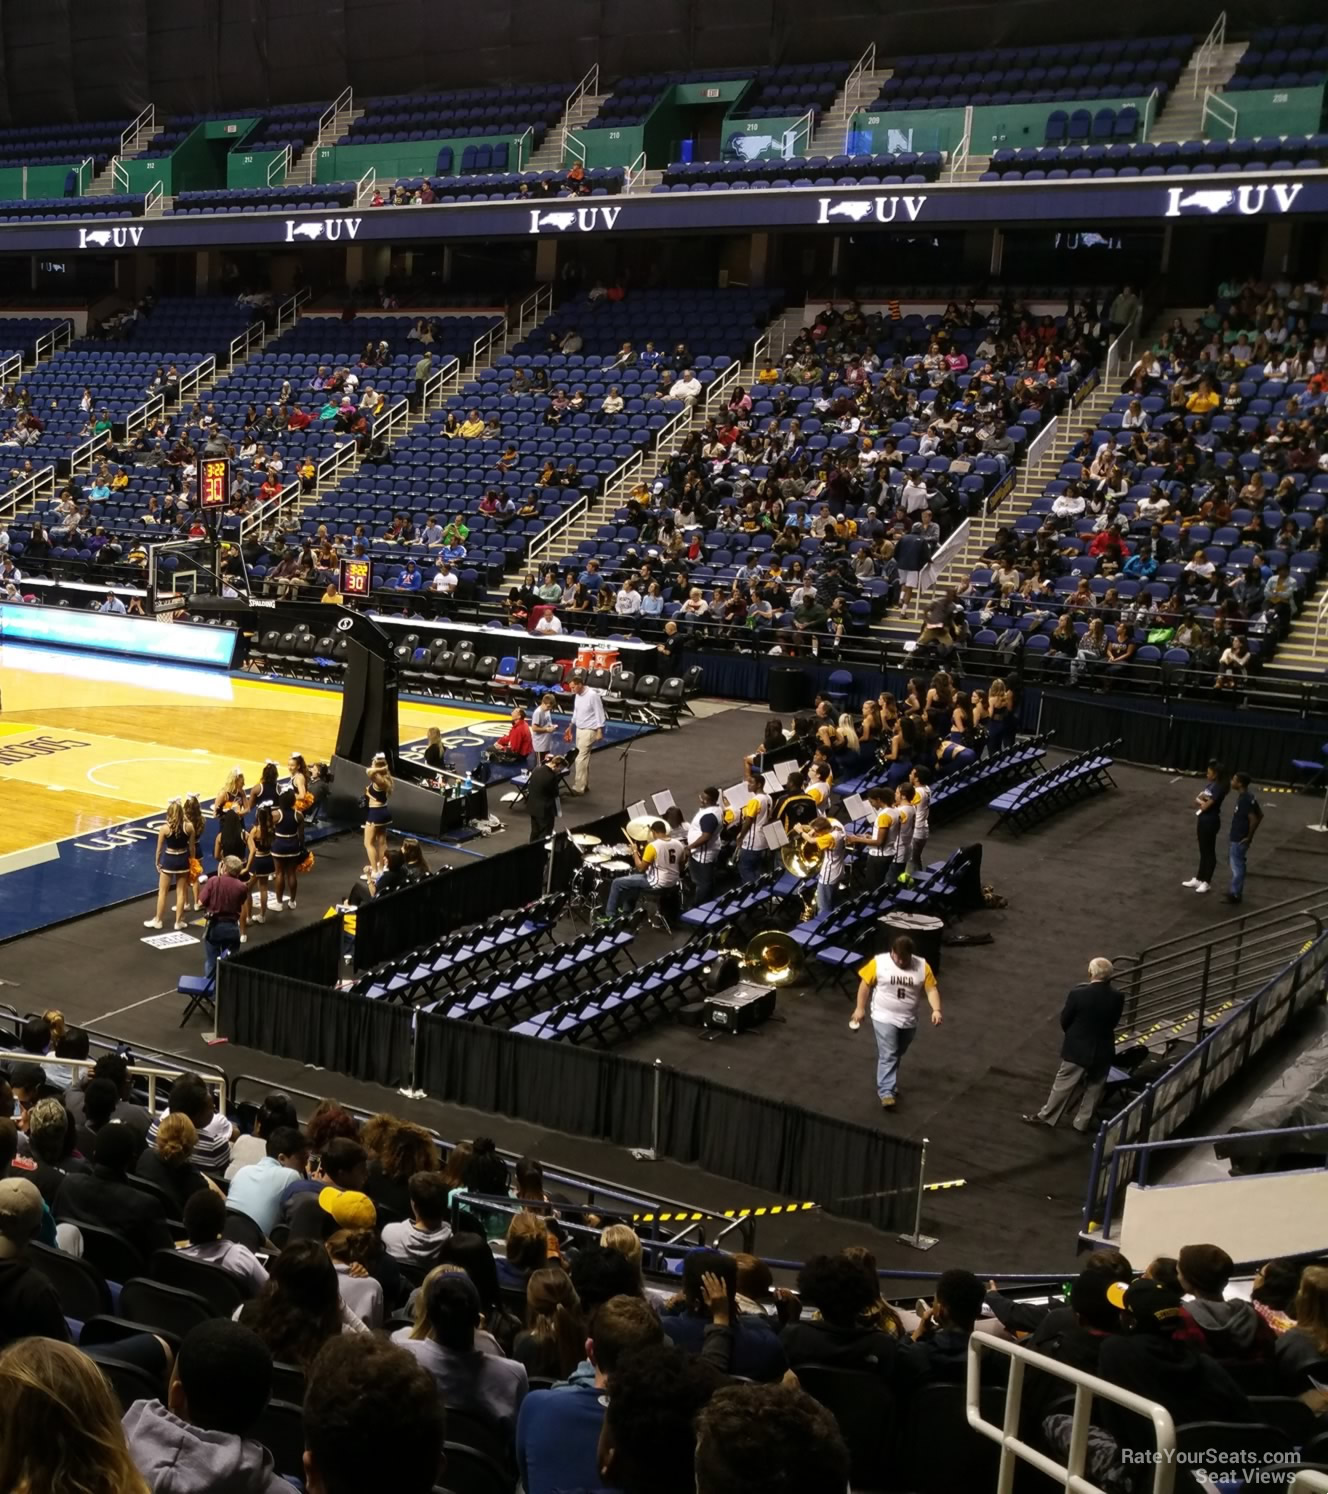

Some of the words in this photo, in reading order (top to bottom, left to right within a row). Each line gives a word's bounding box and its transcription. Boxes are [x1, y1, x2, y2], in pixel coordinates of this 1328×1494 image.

[868, 117, 880, 125] 209
[1238, 184, 1303, 215] UV
[874, 196, 927, 223] UV
[577, 207, 621, 232] UV
[113, 227, 144, 247] UV
[325, 218, 362, 241] UV
[207, 463, 224, 477] 3:22
[206, 478, 223, 501] 30
[348, 577, 364, 590] 30
[249, 599, 276, 609] SPALDING
[890, 976, 914, 986] UNCG
[897, 988, 906, 999] 6
